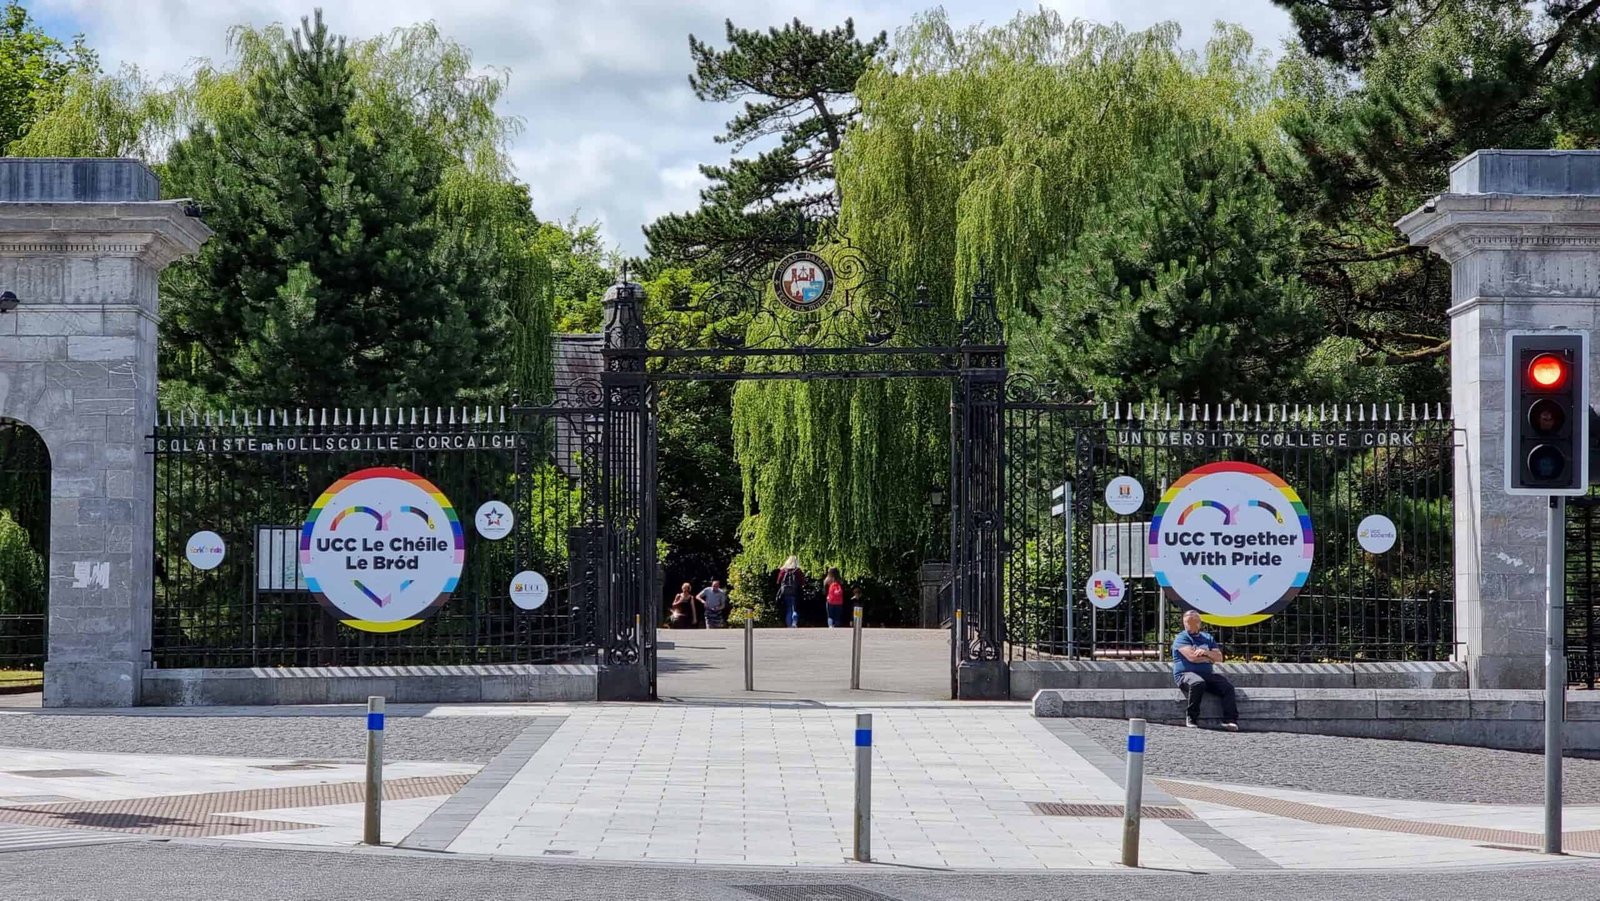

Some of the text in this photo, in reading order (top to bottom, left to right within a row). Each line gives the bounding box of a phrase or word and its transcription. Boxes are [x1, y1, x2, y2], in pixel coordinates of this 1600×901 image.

[415, 435, 515, 449] CORCAIGH
[1119, 431, 1413, 447] UNIVERSITY COLLEGE CORK
[316, 536, 448, 552] UCC Le Chéile
[1164, 531, 1298, 548] UCC Together
[345, 554, 419, 570] Le Bród
[1180, 551, 1282, 566] With Pride
